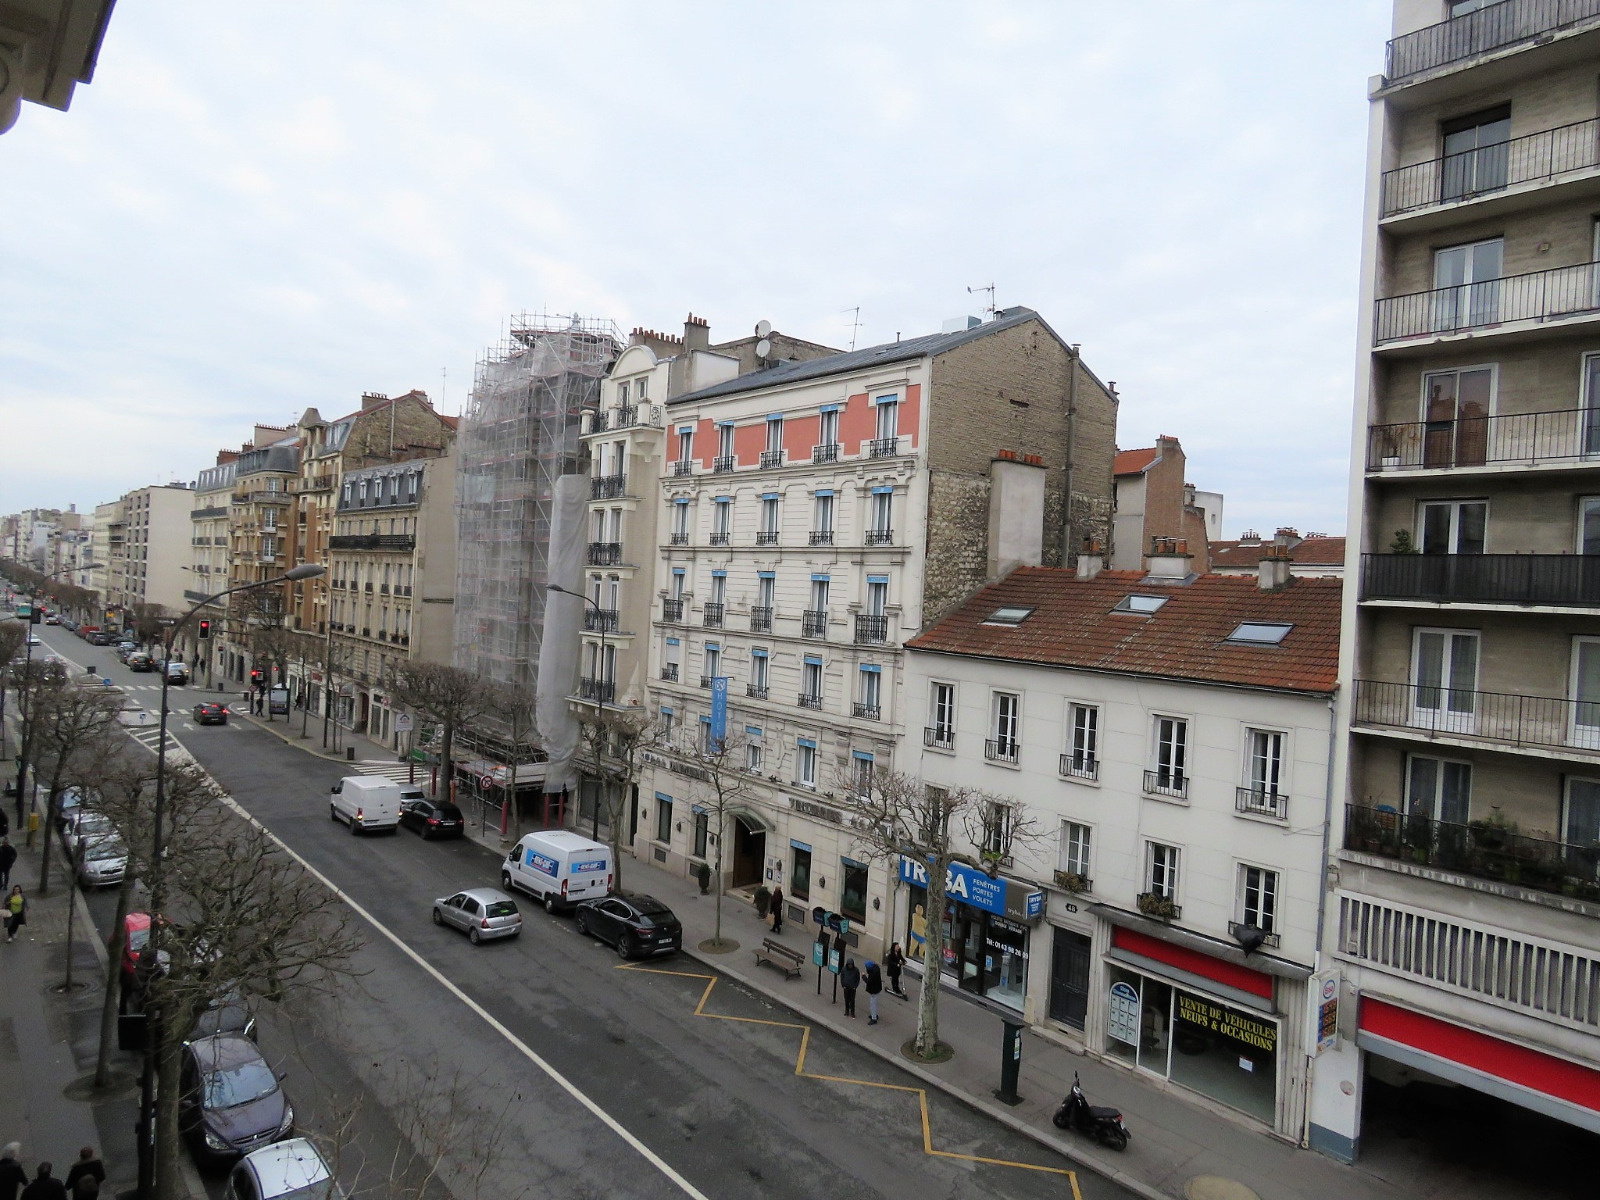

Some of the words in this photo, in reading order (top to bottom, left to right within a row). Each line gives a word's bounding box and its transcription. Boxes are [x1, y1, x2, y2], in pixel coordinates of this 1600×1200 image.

[901, 855, 968, 898] TRBA
[972, 886, 993, 899] PORTES
[972, 894, 993, 906] VOLETS
[1179, 995, 1207, 1016] VENTE
[1209, 1007, 1222, 1020] DE
[1180, 1007, 1208, 1027] NEUFS
[1211, 1020, 1218, 1031] &
[1220, 1022, 1273, 1052] OCCASIONS
